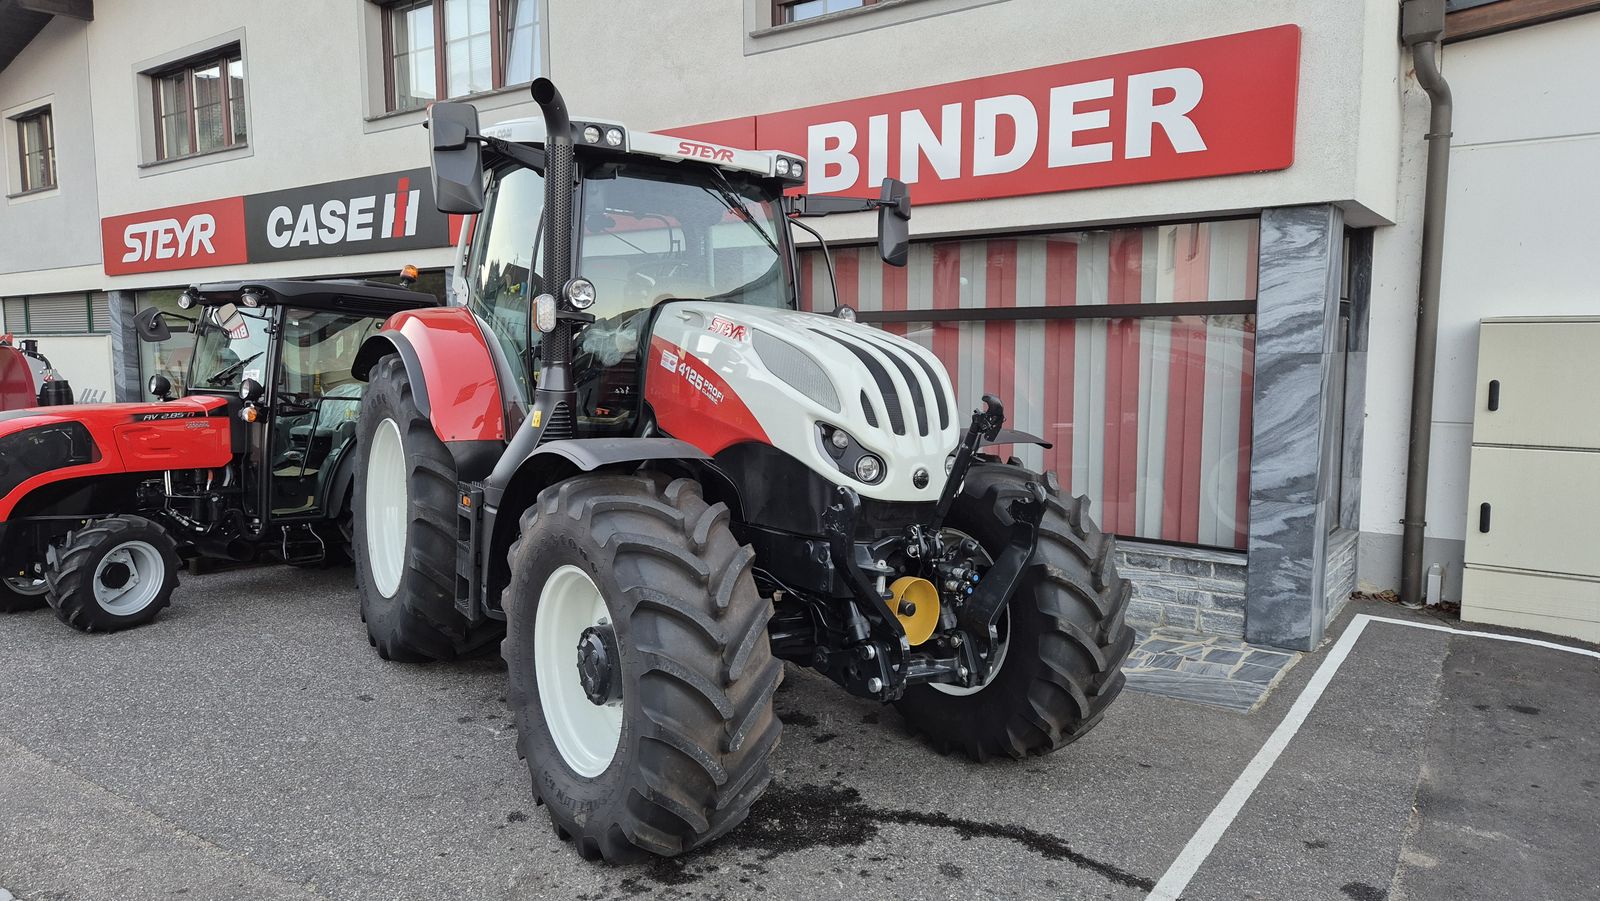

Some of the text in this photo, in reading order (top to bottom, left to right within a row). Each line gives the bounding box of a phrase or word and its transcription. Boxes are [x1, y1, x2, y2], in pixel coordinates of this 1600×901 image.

[806, 66, 1208, 195] BINDER
[677, 141, 735, 163] STEYR
[122, 213, 216, 263] STEYR
[266, 195, 376, 249] CASE
[708, 317, 747, 341] STEYR
[704, 380, 724, 402] PROFI
